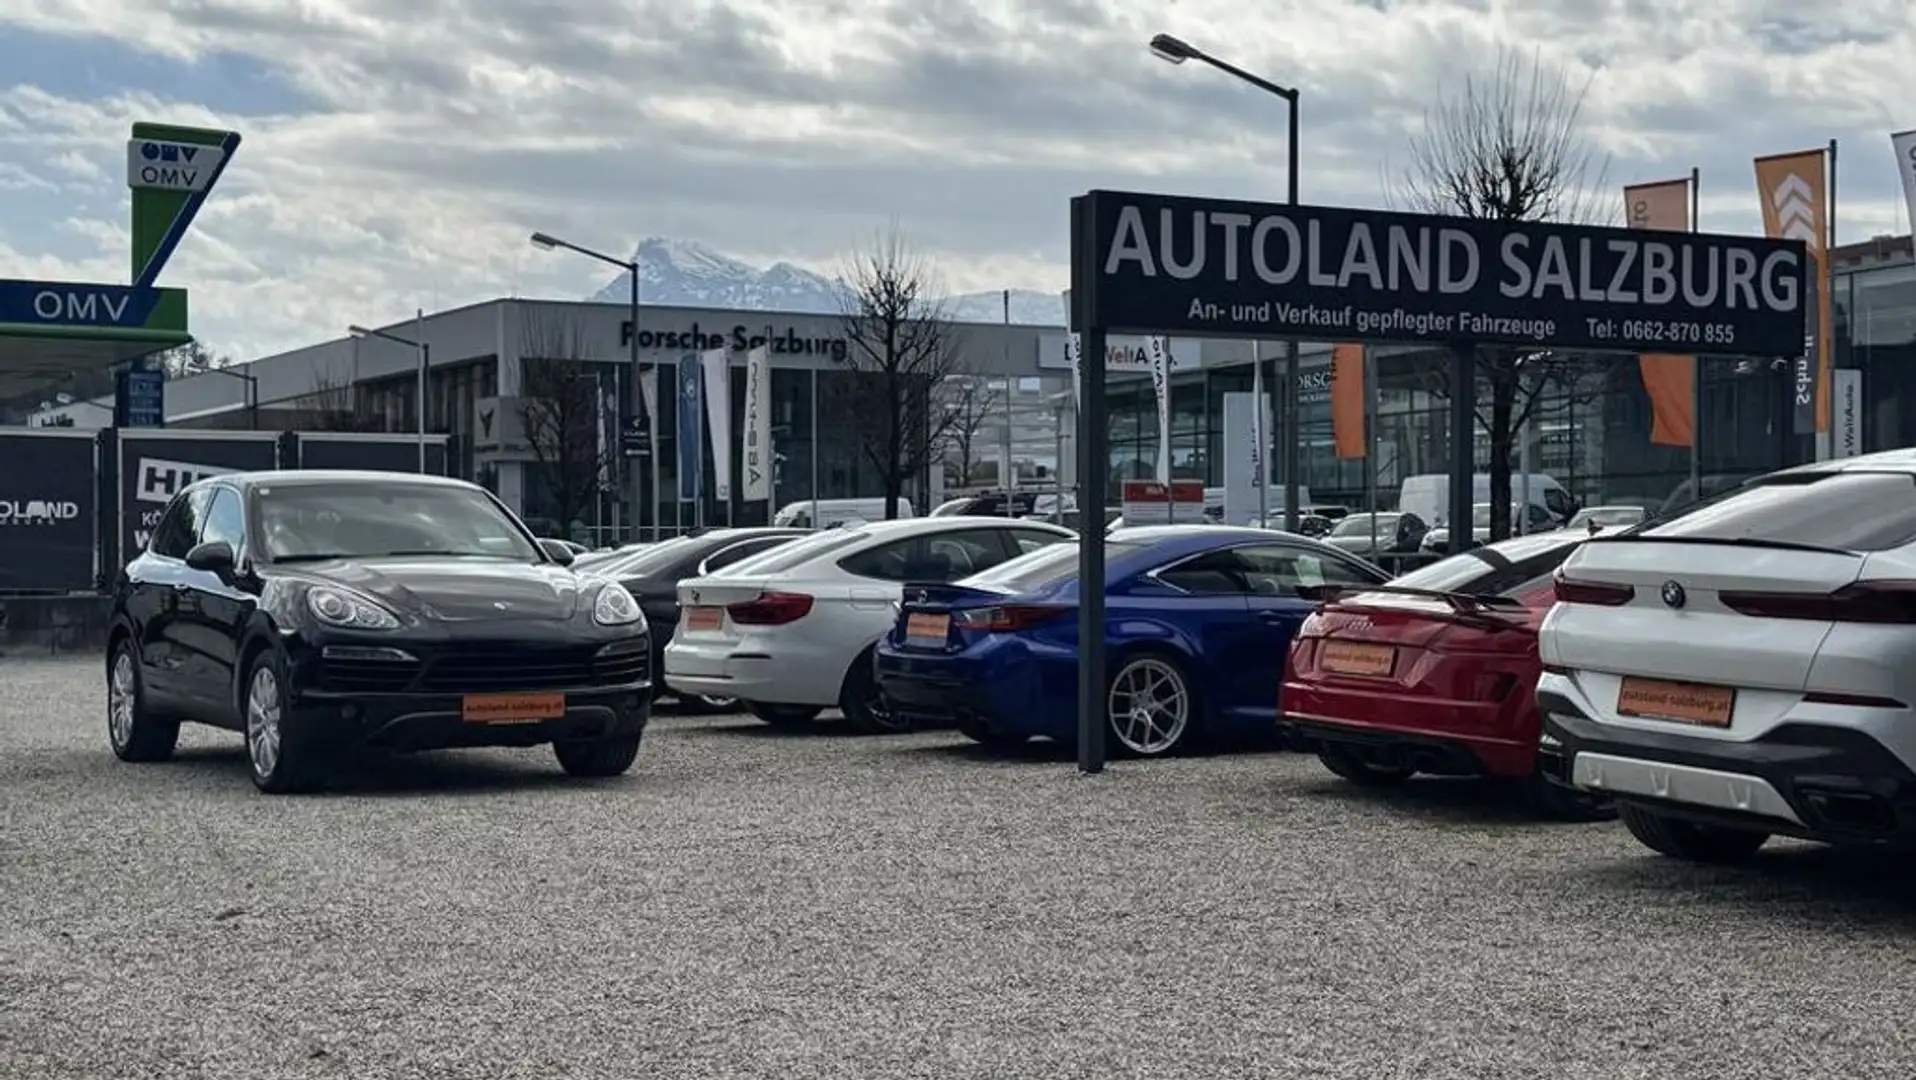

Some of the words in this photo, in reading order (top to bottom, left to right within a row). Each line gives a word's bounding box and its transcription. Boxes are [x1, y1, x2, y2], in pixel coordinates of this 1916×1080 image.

[142, 166, 197, 187] OMV
[1104, 205, 1480, 293] AUTOLAND
[1500, 232, 1798, 311] SALZBURG
[34, 290, 129, 321] OMV
[1187, 298, 1225, 320] An-
[1232, 301, 1269, 322] und
[1276, 303, 1351, 326] Verkauf
[1357, 307, 1454, 335] gepflegter
[1459, 312, 1556, 339] Fahrzeuge
[1586, 318, 1618, 338] Tel:
[1623, 320, 1700, 342] 0662-870
[1705, 324, 1734, 343] 855
[733, 325, 847, 362] Salzburg
